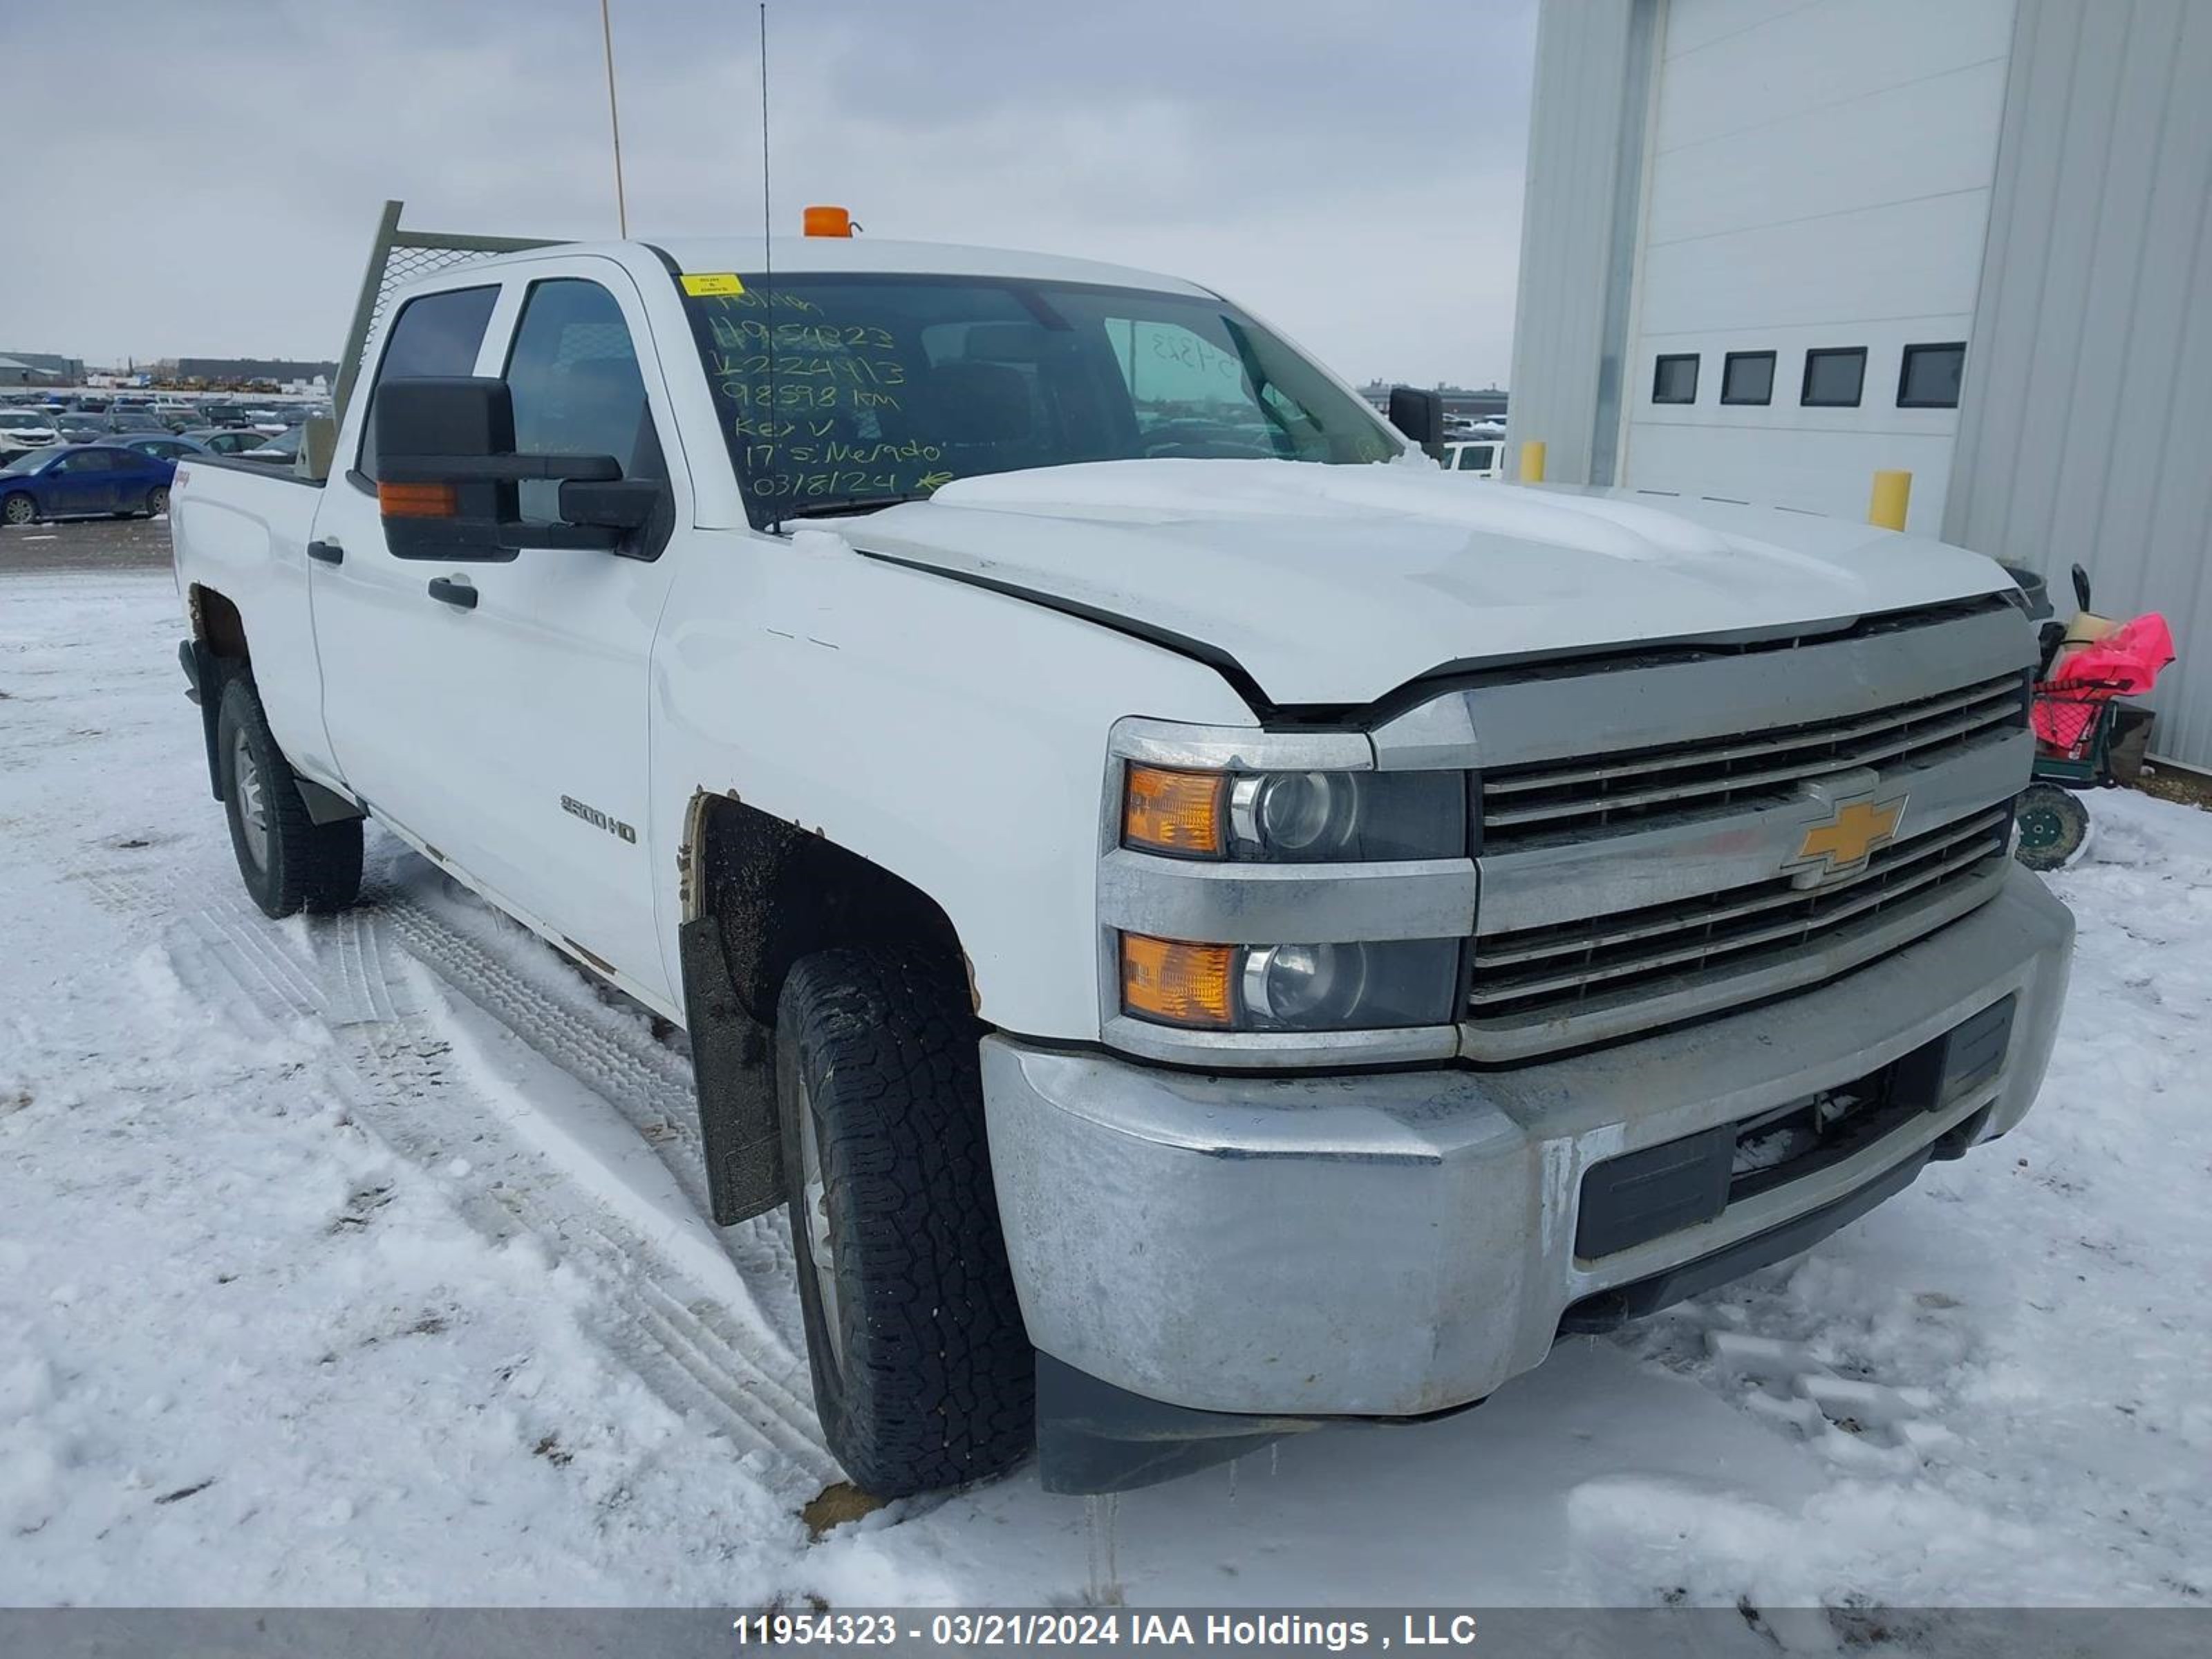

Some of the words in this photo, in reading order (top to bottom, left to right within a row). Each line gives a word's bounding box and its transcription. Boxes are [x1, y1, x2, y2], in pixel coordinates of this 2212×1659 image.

[722, 382, 836, 408] 98598
[561, 794, 607, 830] 2500
[608, 816, 637, 845] HD
